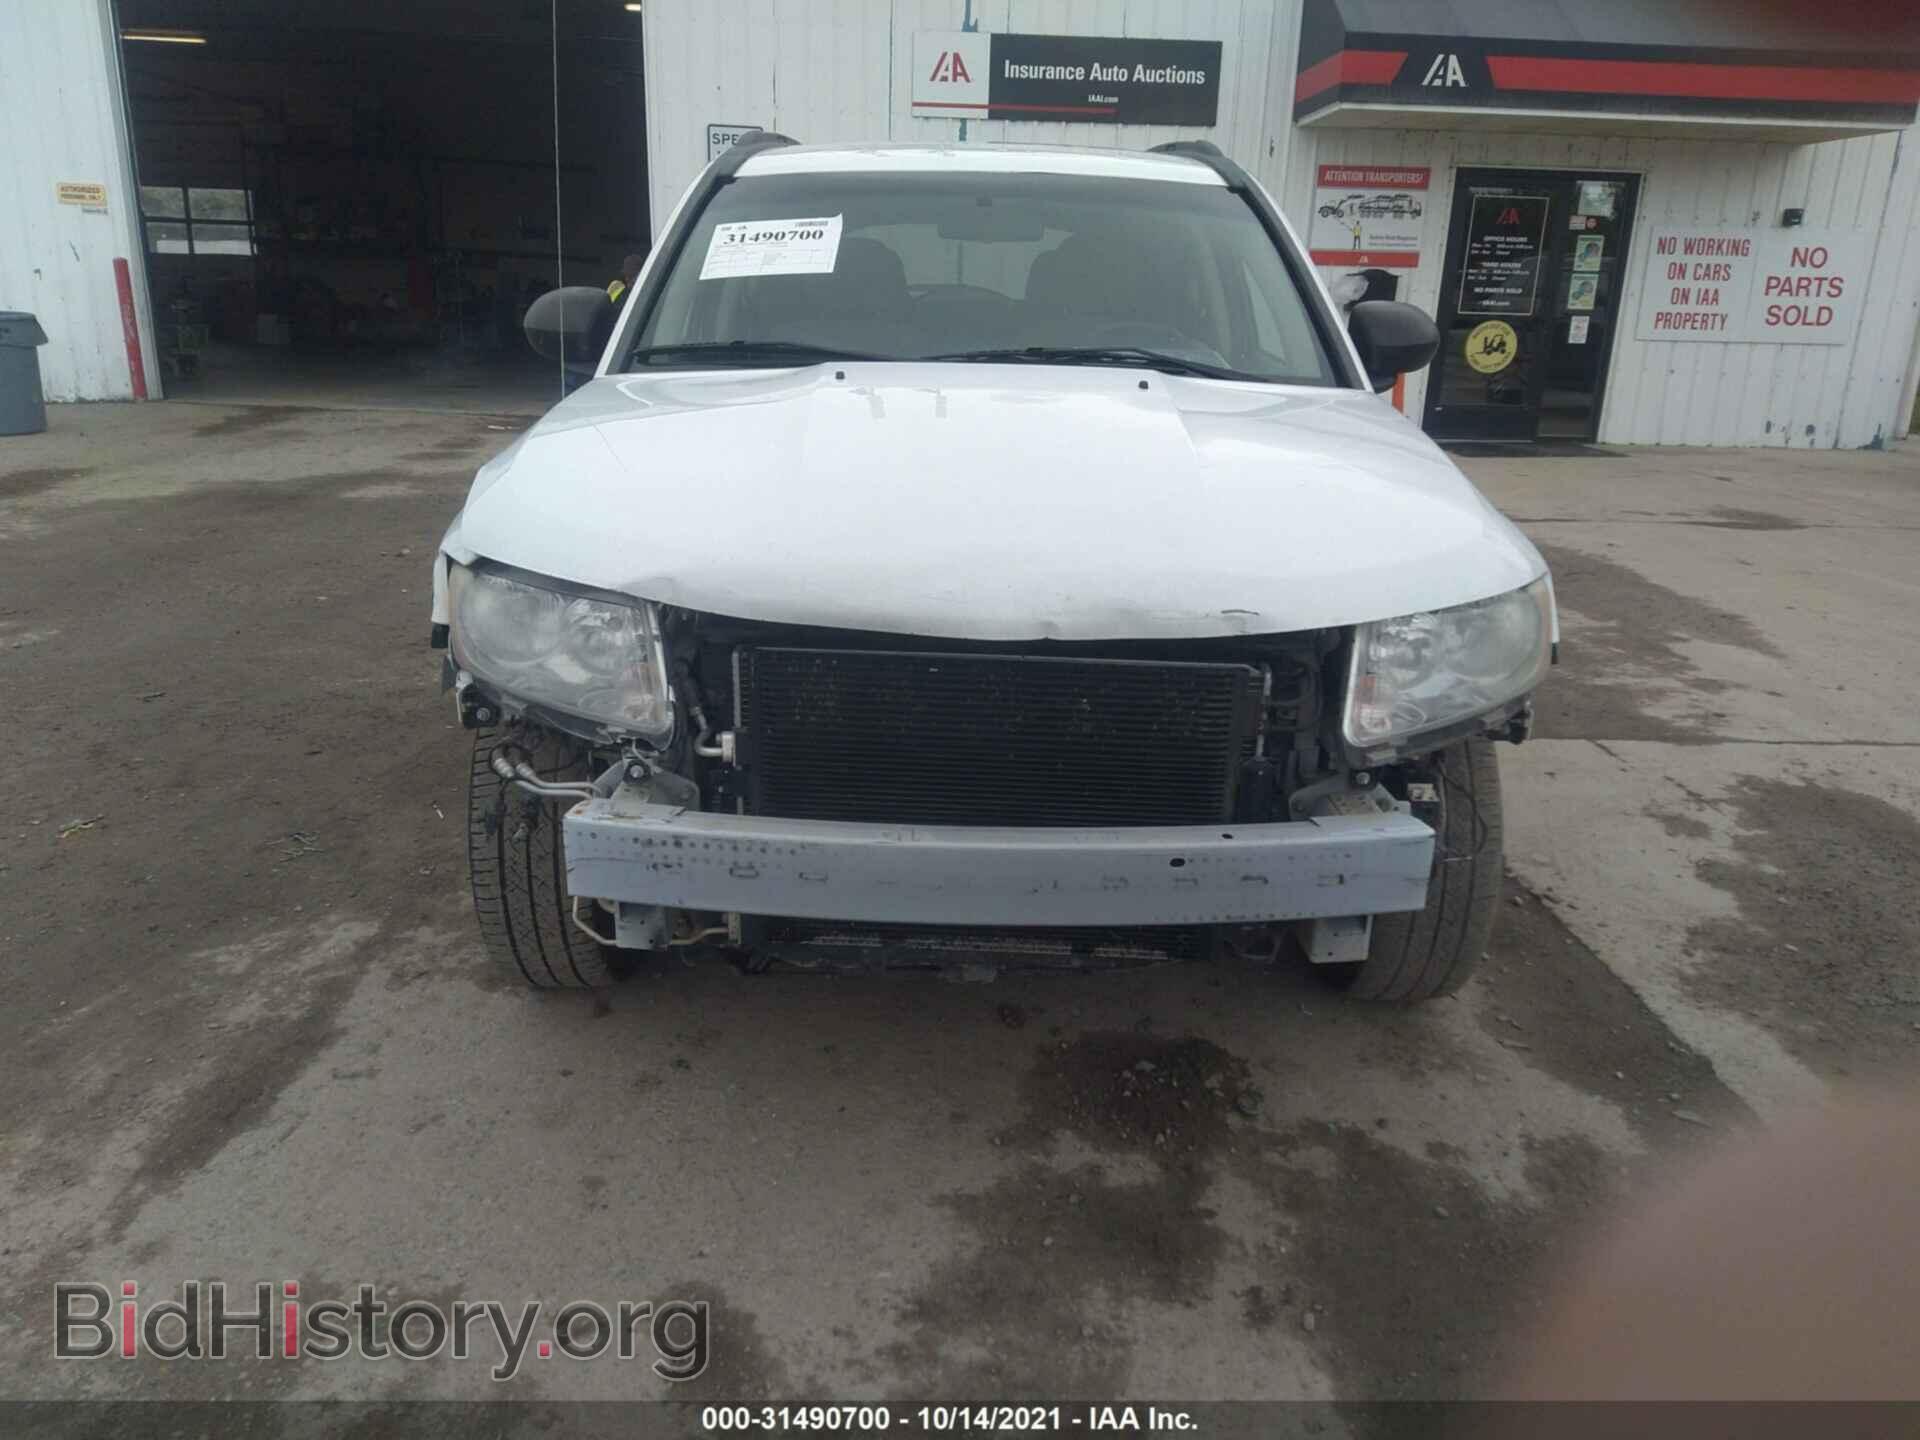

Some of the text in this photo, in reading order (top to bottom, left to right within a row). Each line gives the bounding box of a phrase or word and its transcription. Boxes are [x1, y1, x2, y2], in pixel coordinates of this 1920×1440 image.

[1004, 60, 1206, 85] Insurance Auto Auctions
[1324, 170, 1364, 184] ATTENTION
[723, 230, 824, 245] 31490700
[1657, 236, 1751, 257] NO WORKING
[1790, 247, 1828, 268] NO
[1667, 262, 1732, 281] ON CARS
[1670, 287, 1720, 306] ON IAA
[1764, 276, 1844, 298] PARTS
[1654, 312, 1728, 330] PROPERTY
[1764, 305, 1833, 326] SOLD
